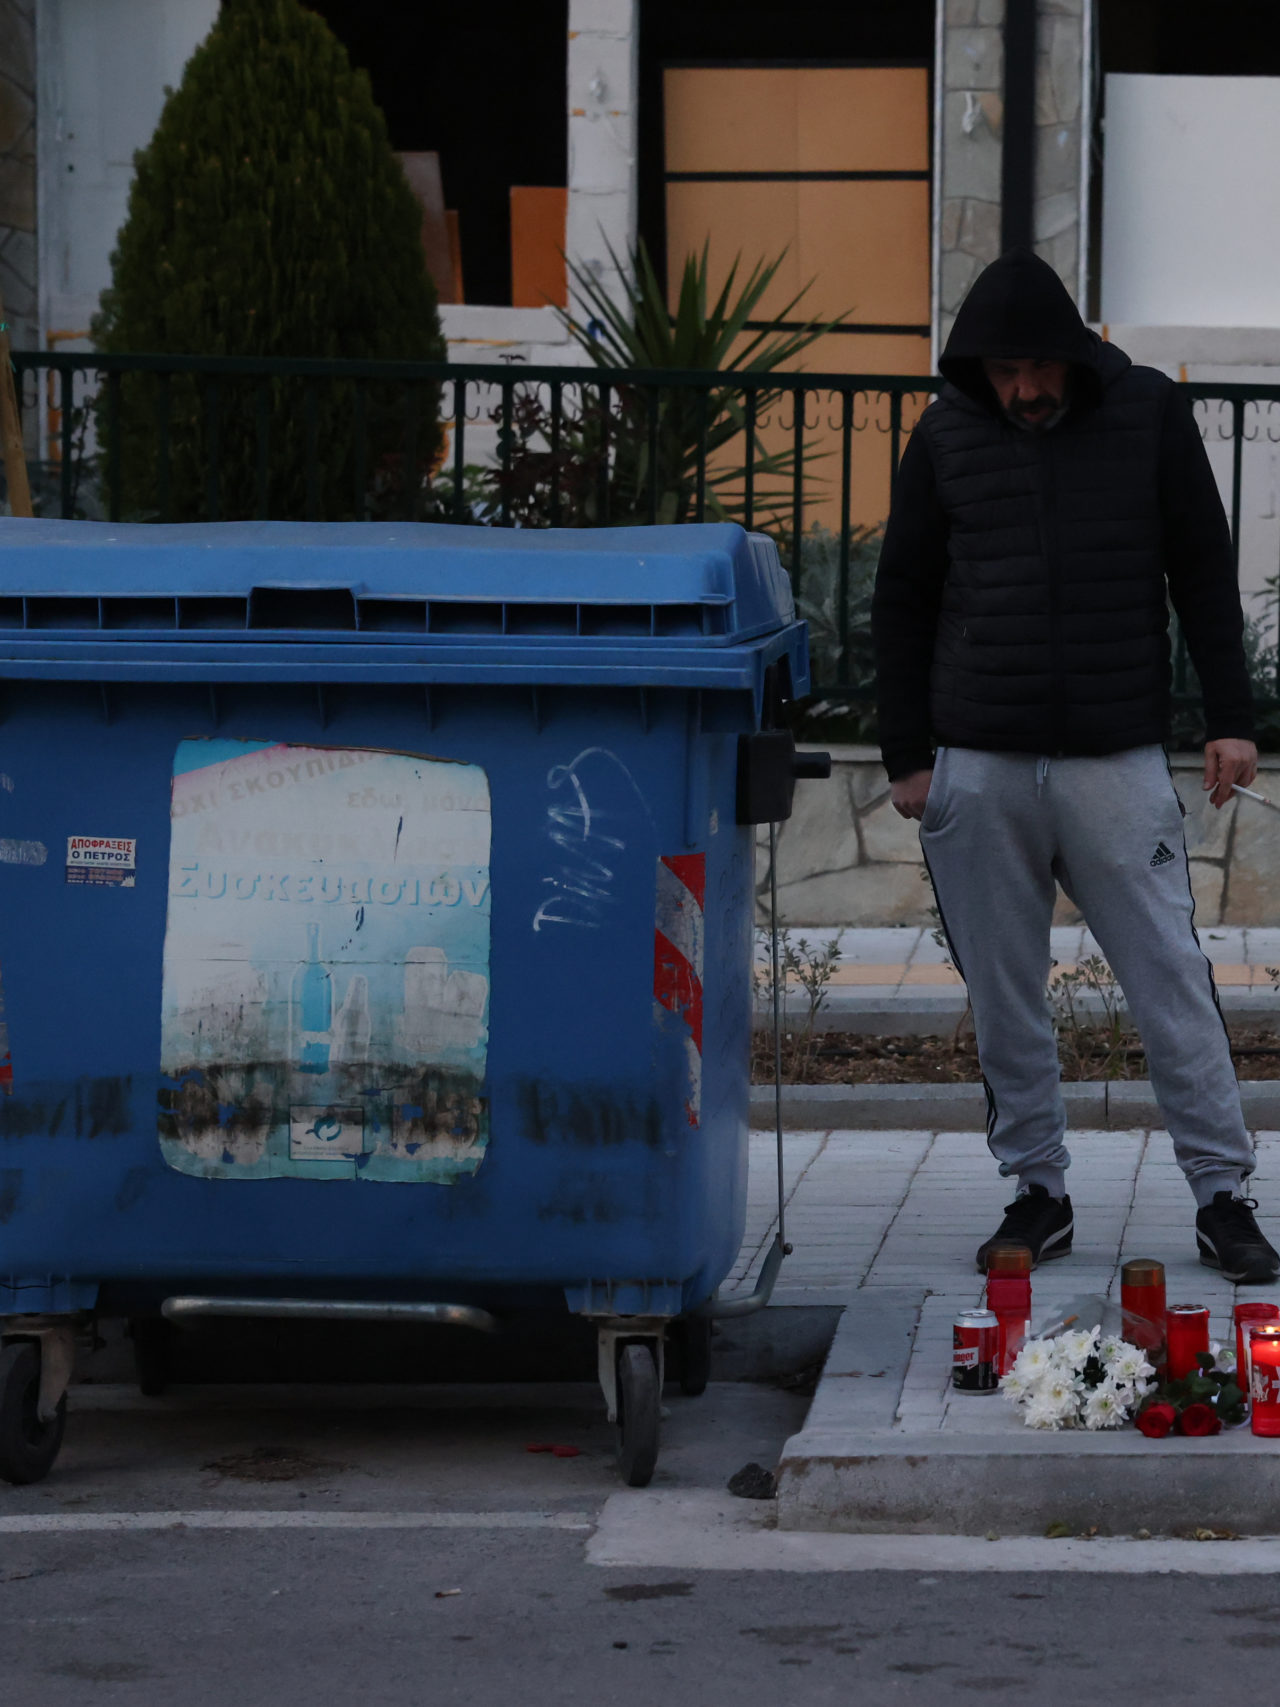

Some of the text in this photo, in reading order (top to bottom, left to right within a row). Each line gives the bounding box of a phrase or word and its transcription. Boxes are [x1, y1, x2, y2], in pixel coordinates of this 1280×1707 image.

[71, 838, 132, 853] ΑΠΟΦΡΑΞΕΙΣ
[72, 851, 130, 862] Ο ΠΕΤΡΟΣ
